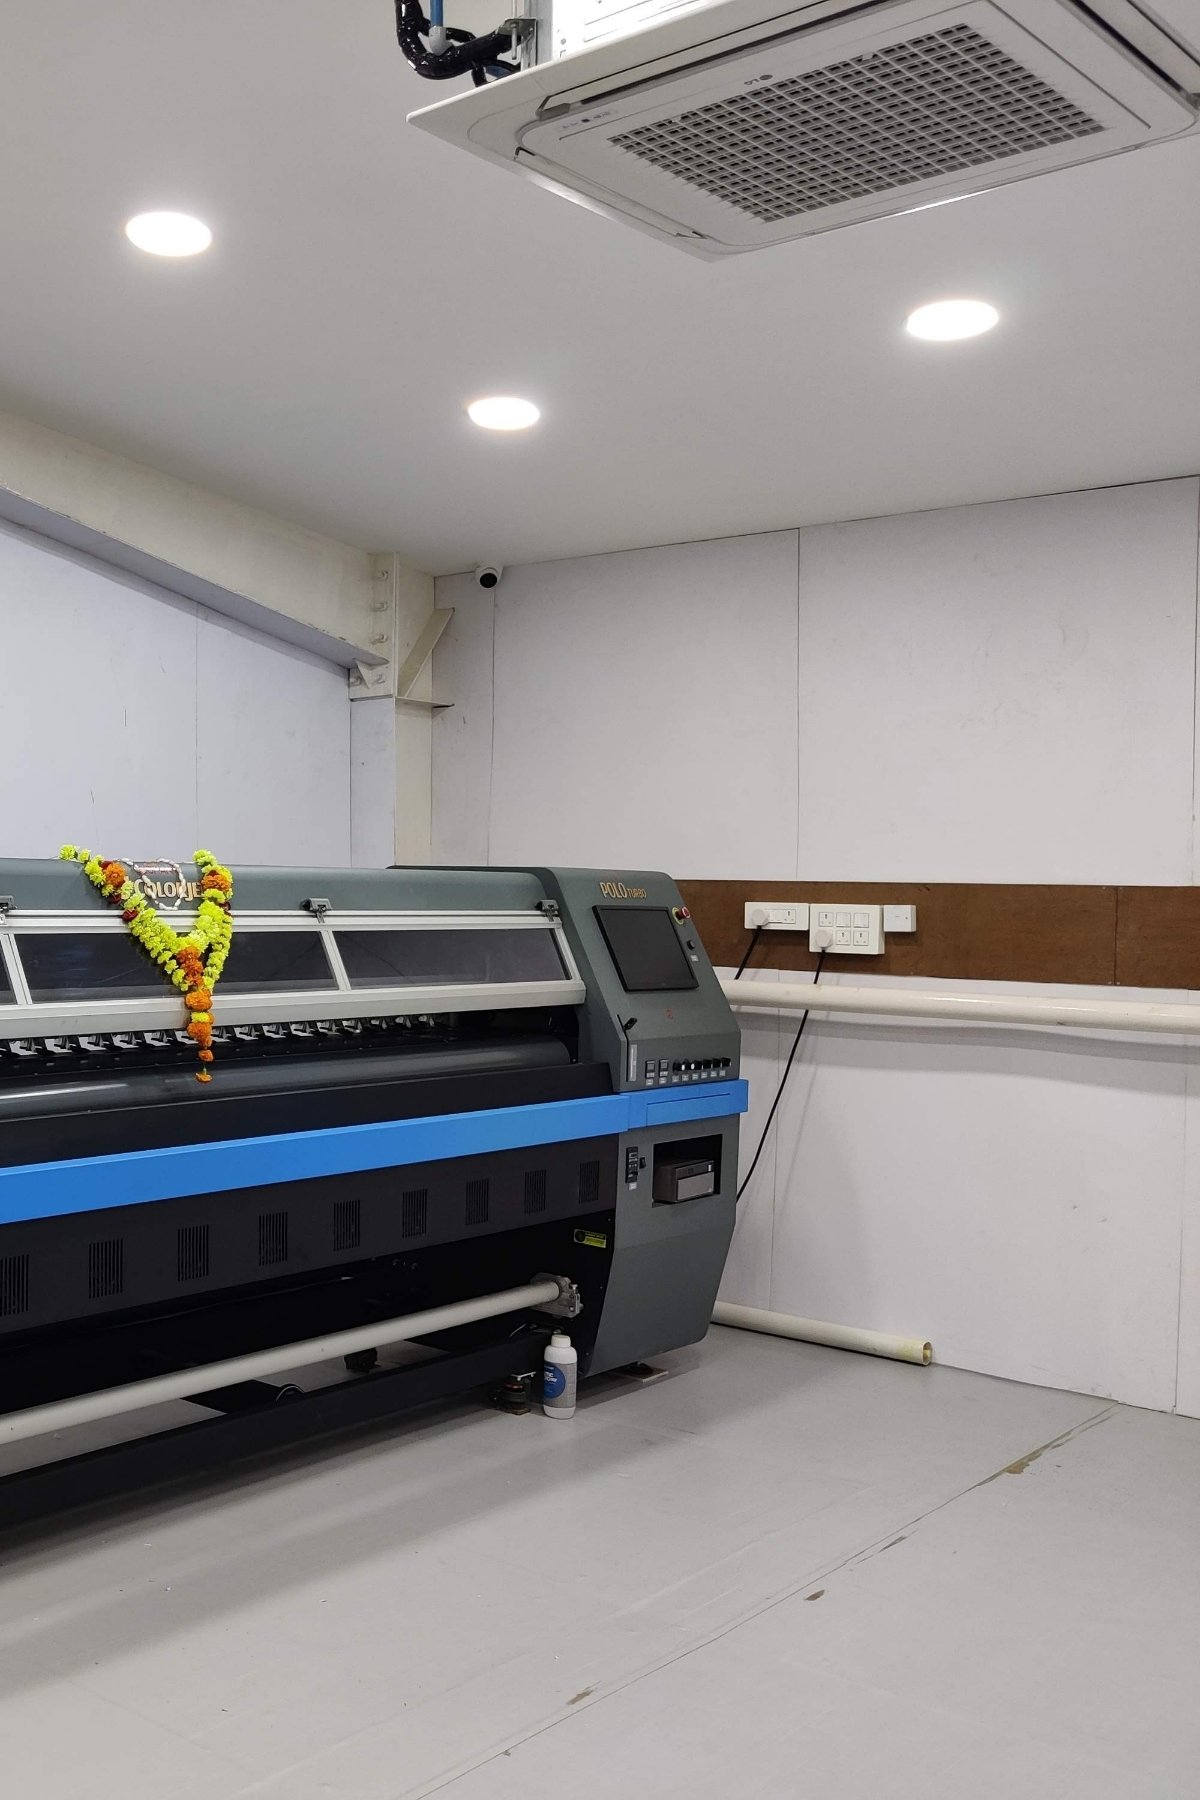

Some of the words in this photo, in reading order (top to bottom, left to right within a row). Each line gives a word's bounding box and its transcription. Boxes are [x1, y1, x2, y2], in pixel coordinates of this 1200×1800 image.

[134, 879, 202, 902] COLORJE
[599, 882, 627, 899] POLO
[627, 888, 647, 899] TURBO
